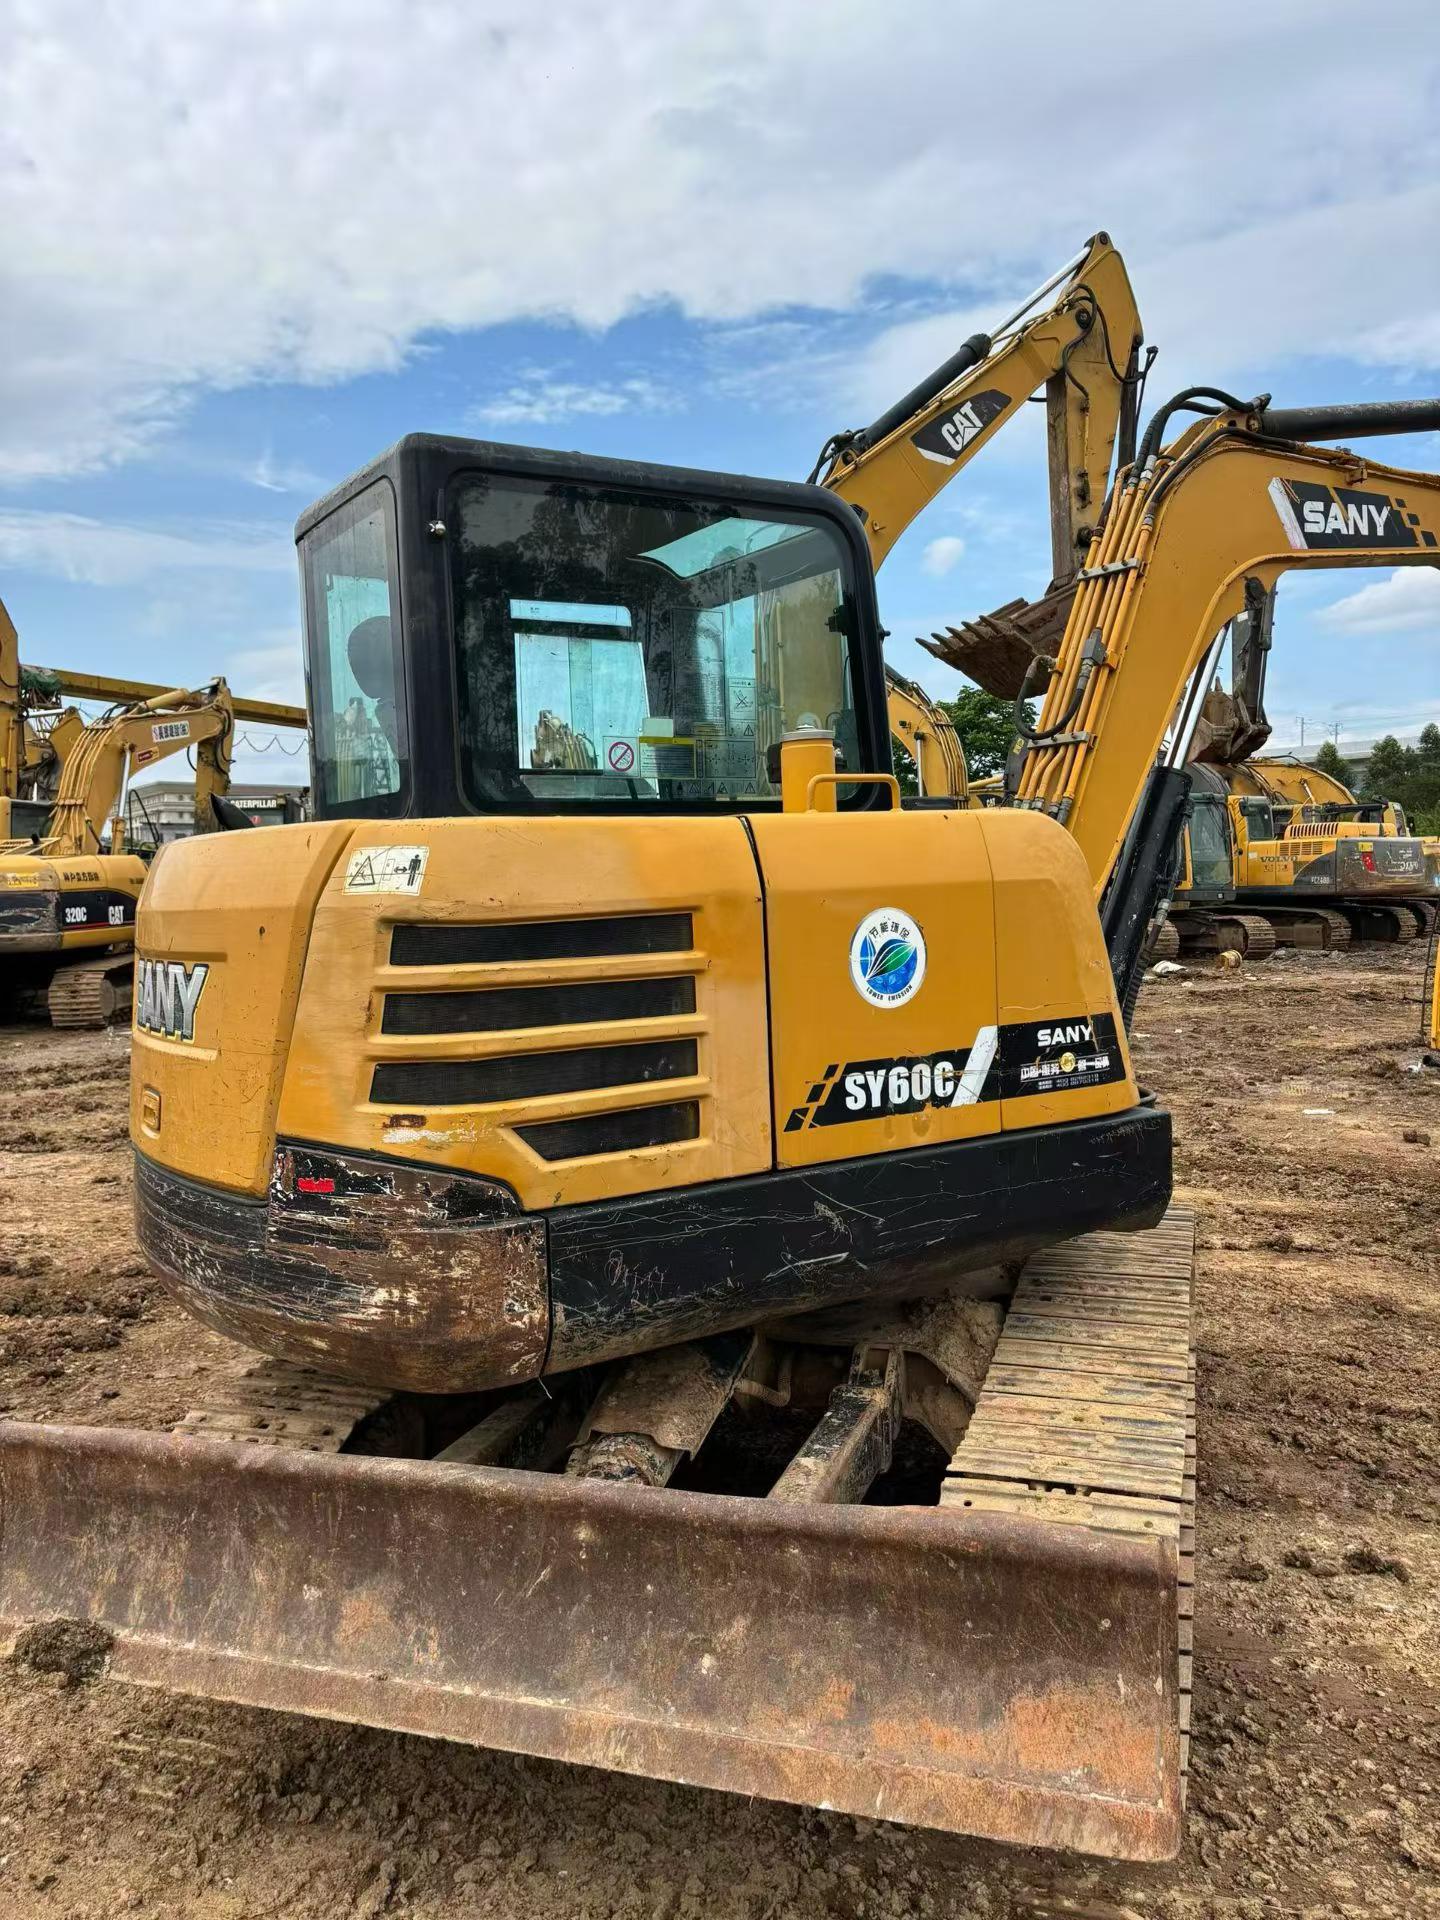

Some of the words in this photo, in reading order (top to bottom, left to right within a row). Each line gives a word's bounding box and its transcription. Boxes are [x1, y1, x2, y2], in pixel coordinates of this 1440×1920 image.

[941, 400, 984, 451] CAT
[1303, 500, 1391, 536] SANY
[65, 906, 87, 923] 320C
[108, 905, 124, 925] CAT
[866, 986, 884, 1001] LOWER
[887, 983, 913, 1002] EMISSION
[1037, 1024, 1093, 1047] SANY
[845, 1061, 954, 1111] SY60C
